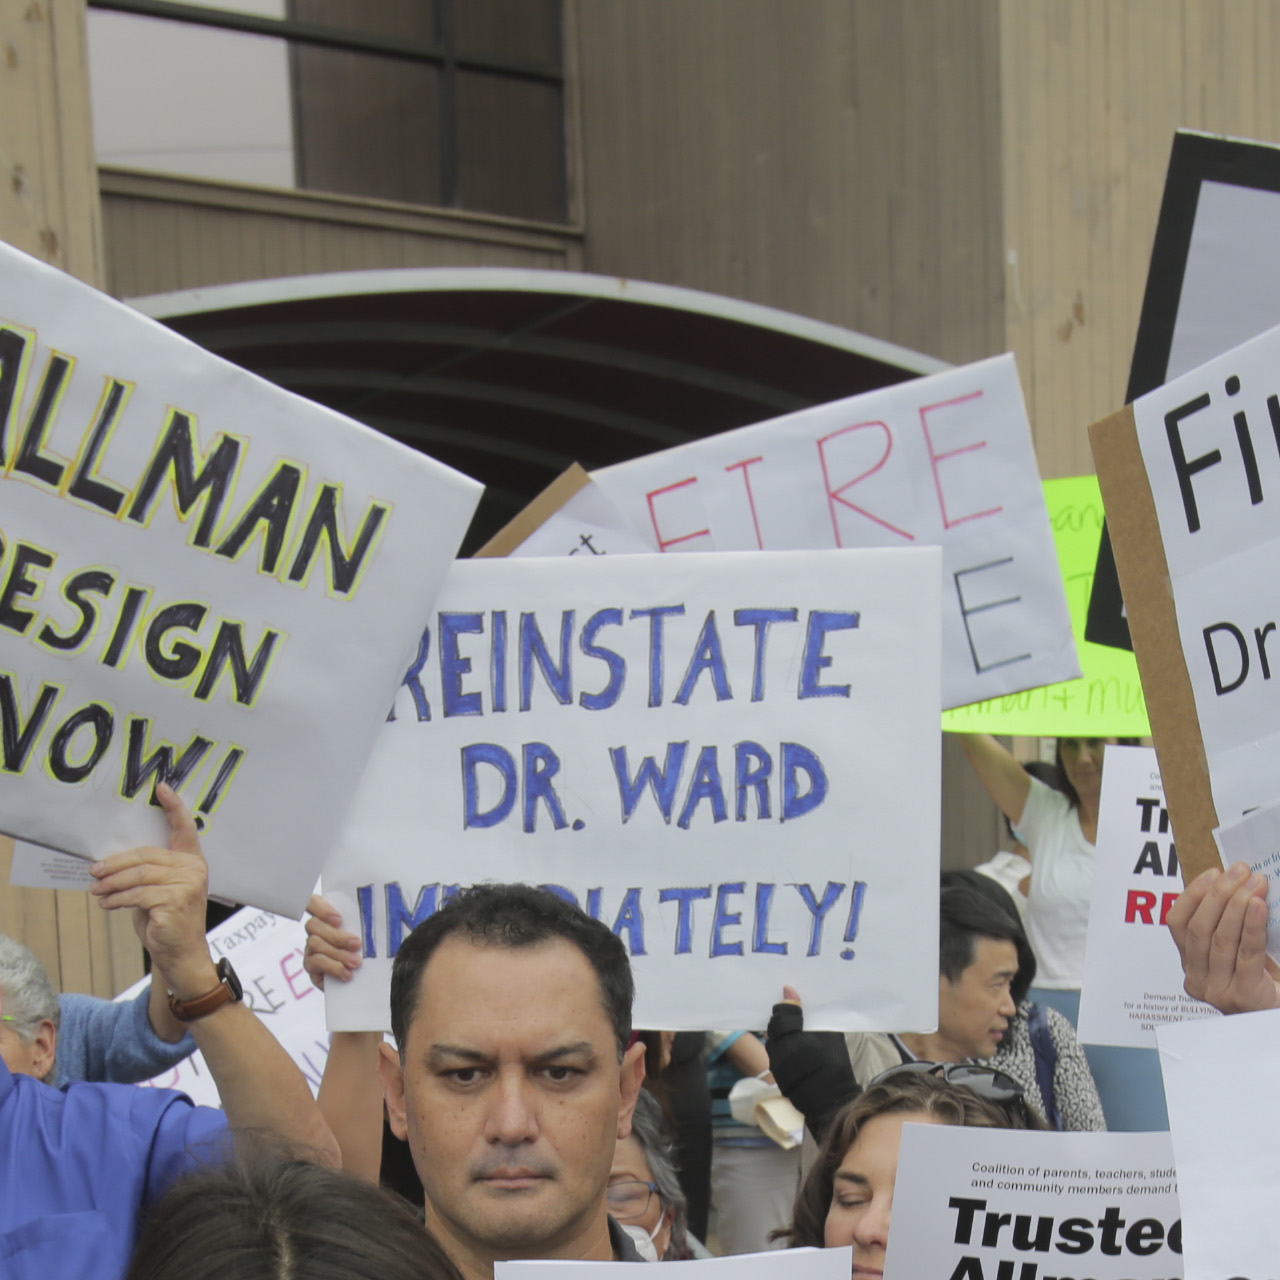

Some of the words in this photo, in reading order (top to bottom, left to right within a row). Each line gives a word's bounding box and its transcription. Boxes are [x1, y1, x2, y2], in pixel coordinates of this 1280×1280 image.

[384, 603, 861, 722] REINSTATE
[460, 742, 587, 834] DR.
[609, 741, 830, 831] WARD
[971, 1179, 993, 1189] and
[997, 1181, 1064, 1196] community
[1068, 1185, 1123, 1195] members
[1126, 1183, 1171, 1195] demand
[972, 1162, 1024, 1176] Coalition
[1028, 1167, 1040, 1176] of
[1043, 1169, 1091, 1180] parents,
[1095, 1170, 1146, 1180] teachers,
